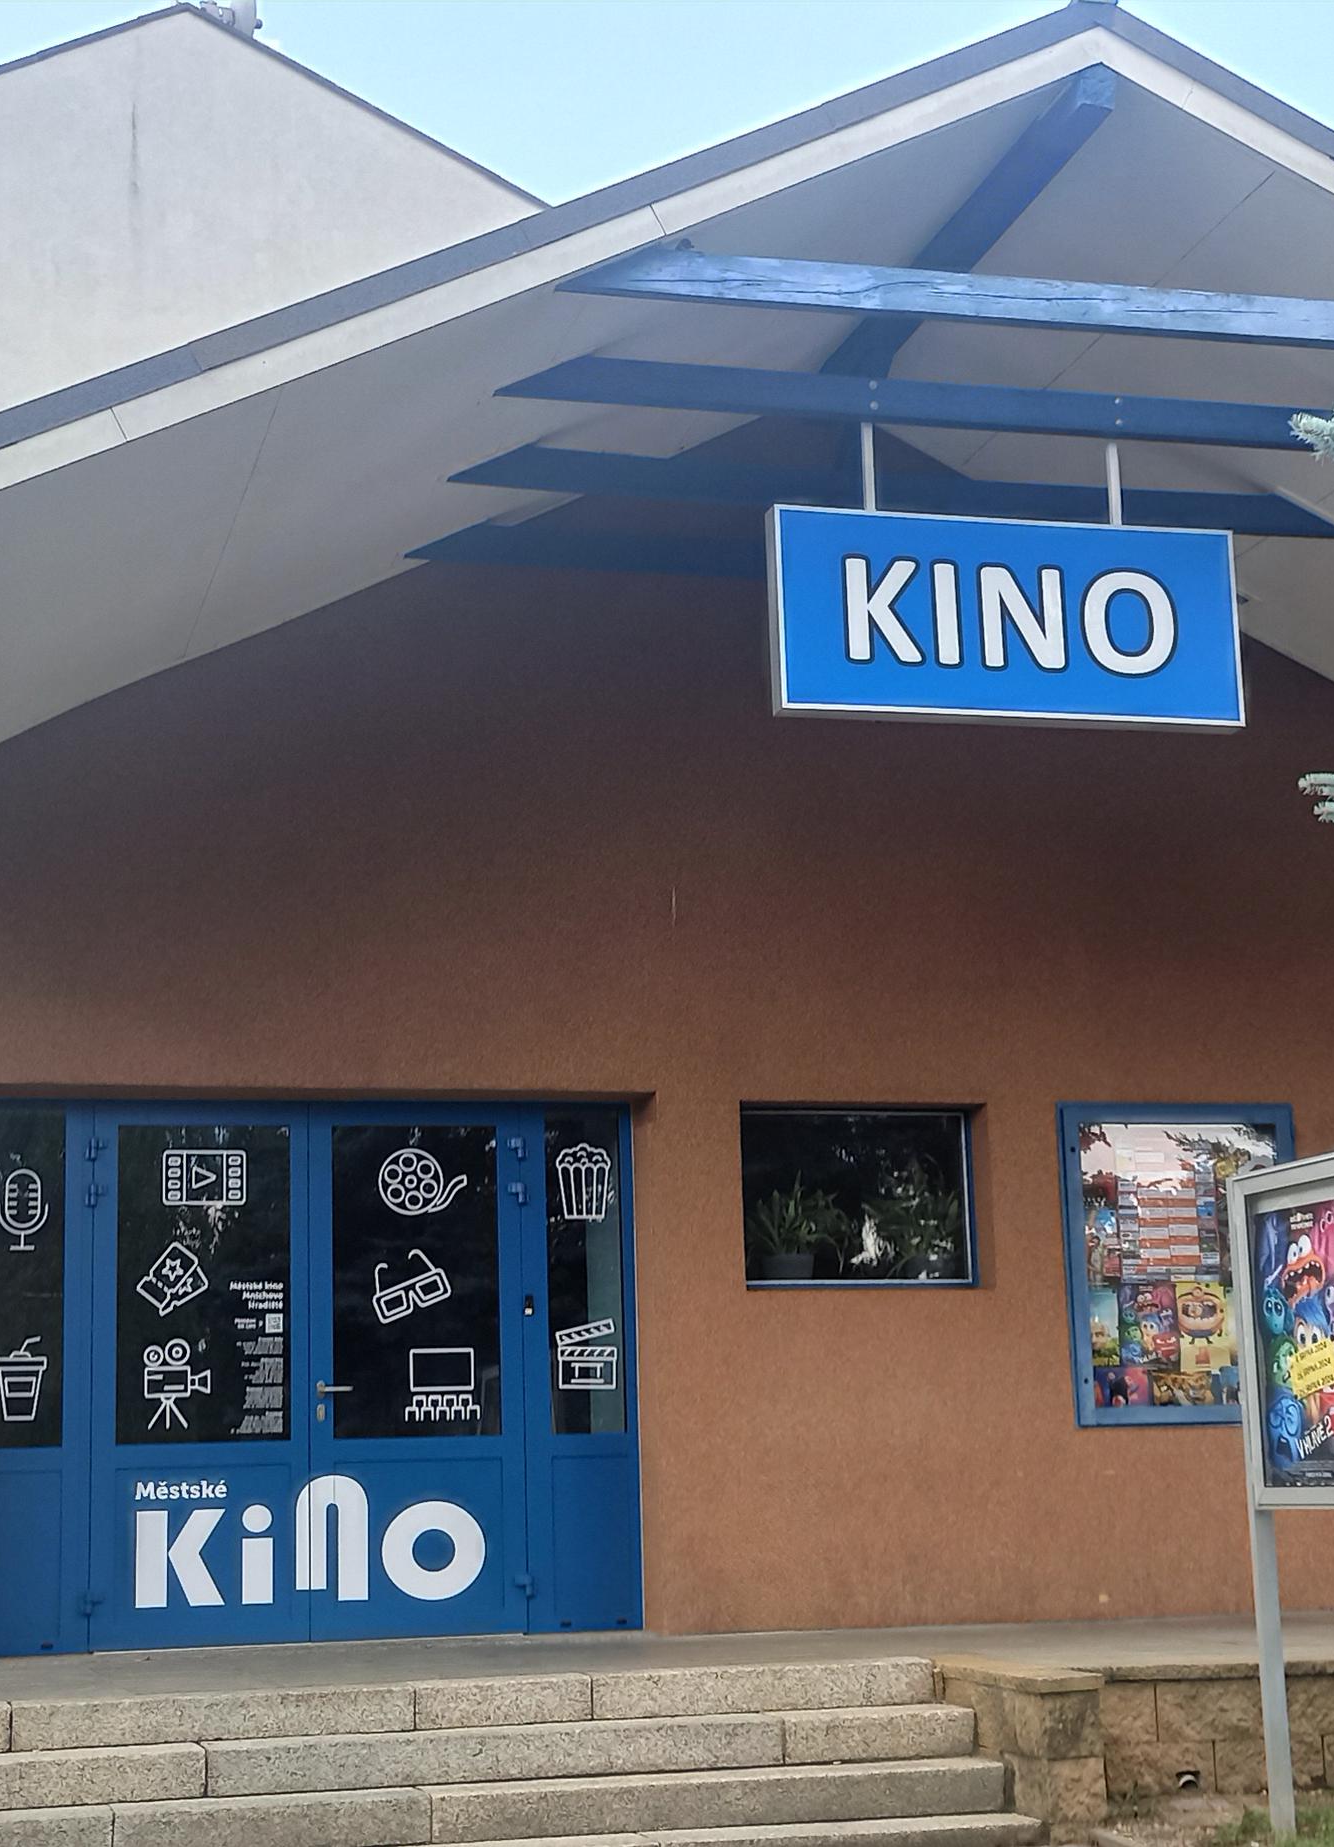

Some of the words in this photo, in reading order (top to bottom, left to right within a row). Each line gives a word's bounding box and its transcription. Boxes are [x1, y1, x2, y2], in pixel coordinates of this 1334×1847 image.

[842, 554, 1178, 678] KINO
[1323, 1415, 1334, 1437] 2
[135, 1479, 228, 1501] Městské
